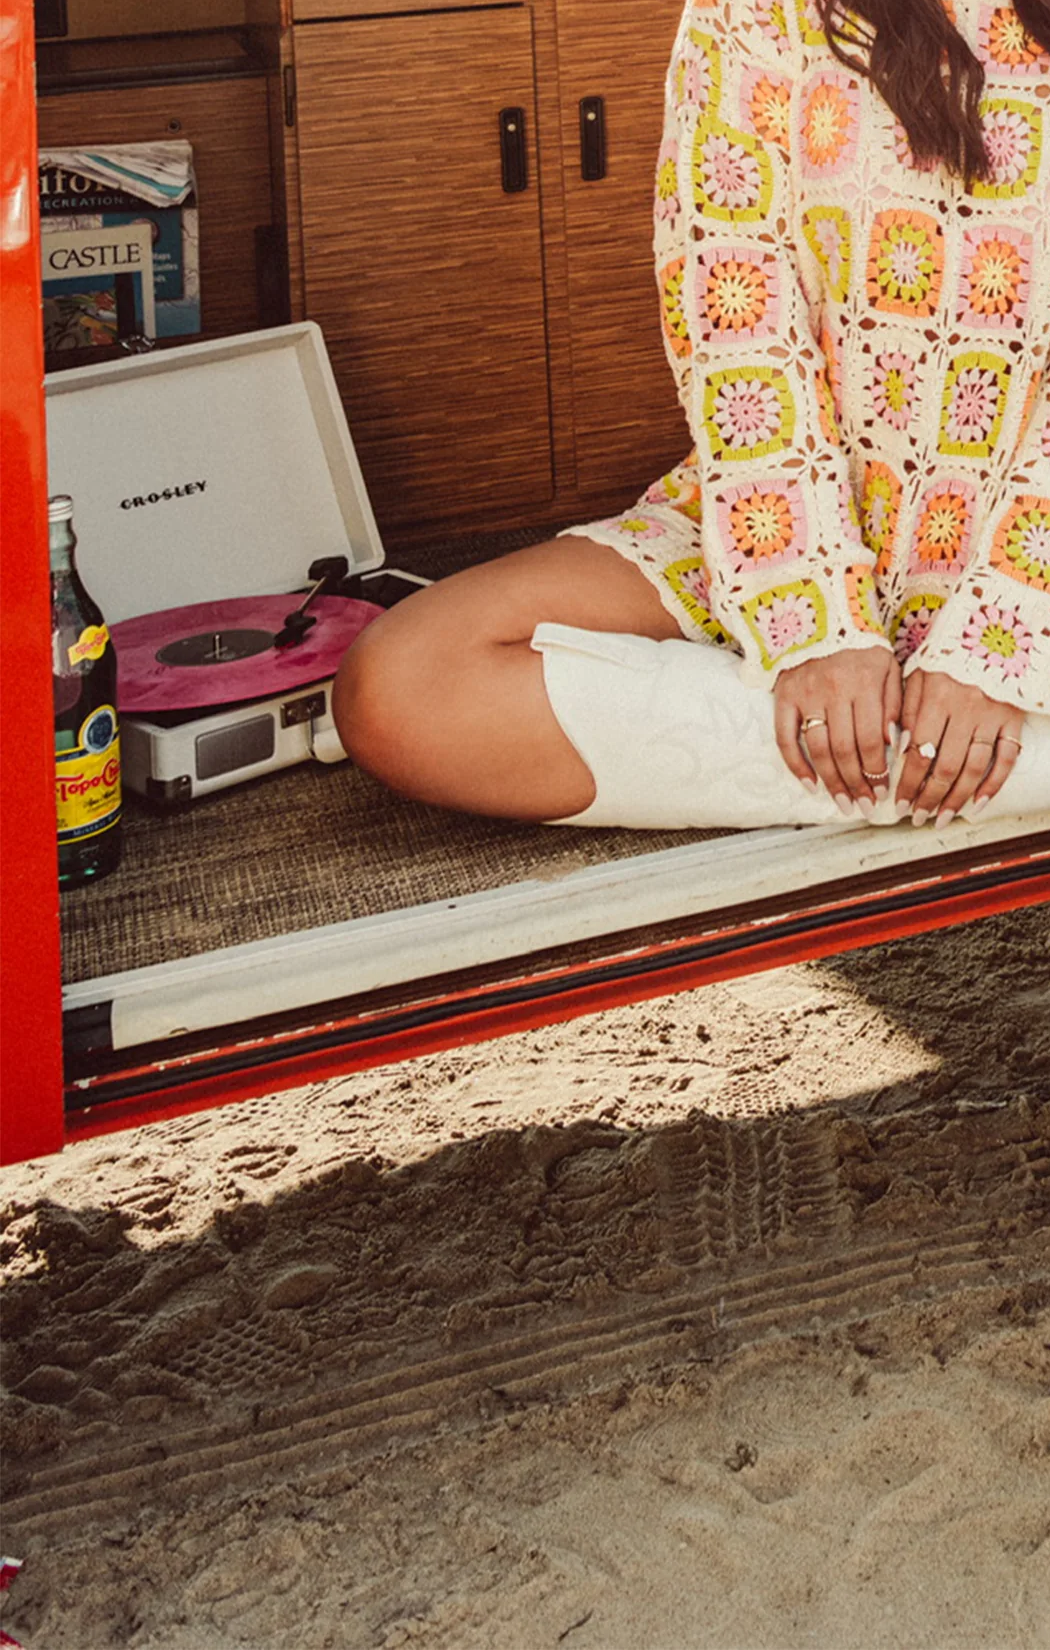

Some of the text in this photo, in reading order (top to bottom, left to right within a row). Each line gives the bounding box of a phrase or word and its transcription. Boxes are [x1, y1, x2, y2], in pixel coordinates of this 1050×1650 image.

[41, 196, 124, 209] ECREATION
[49, 243, 141, 269] CASTLE
[120, 480, 206, 510] CROSLEY
[56, 773, 101, 802] Topo
